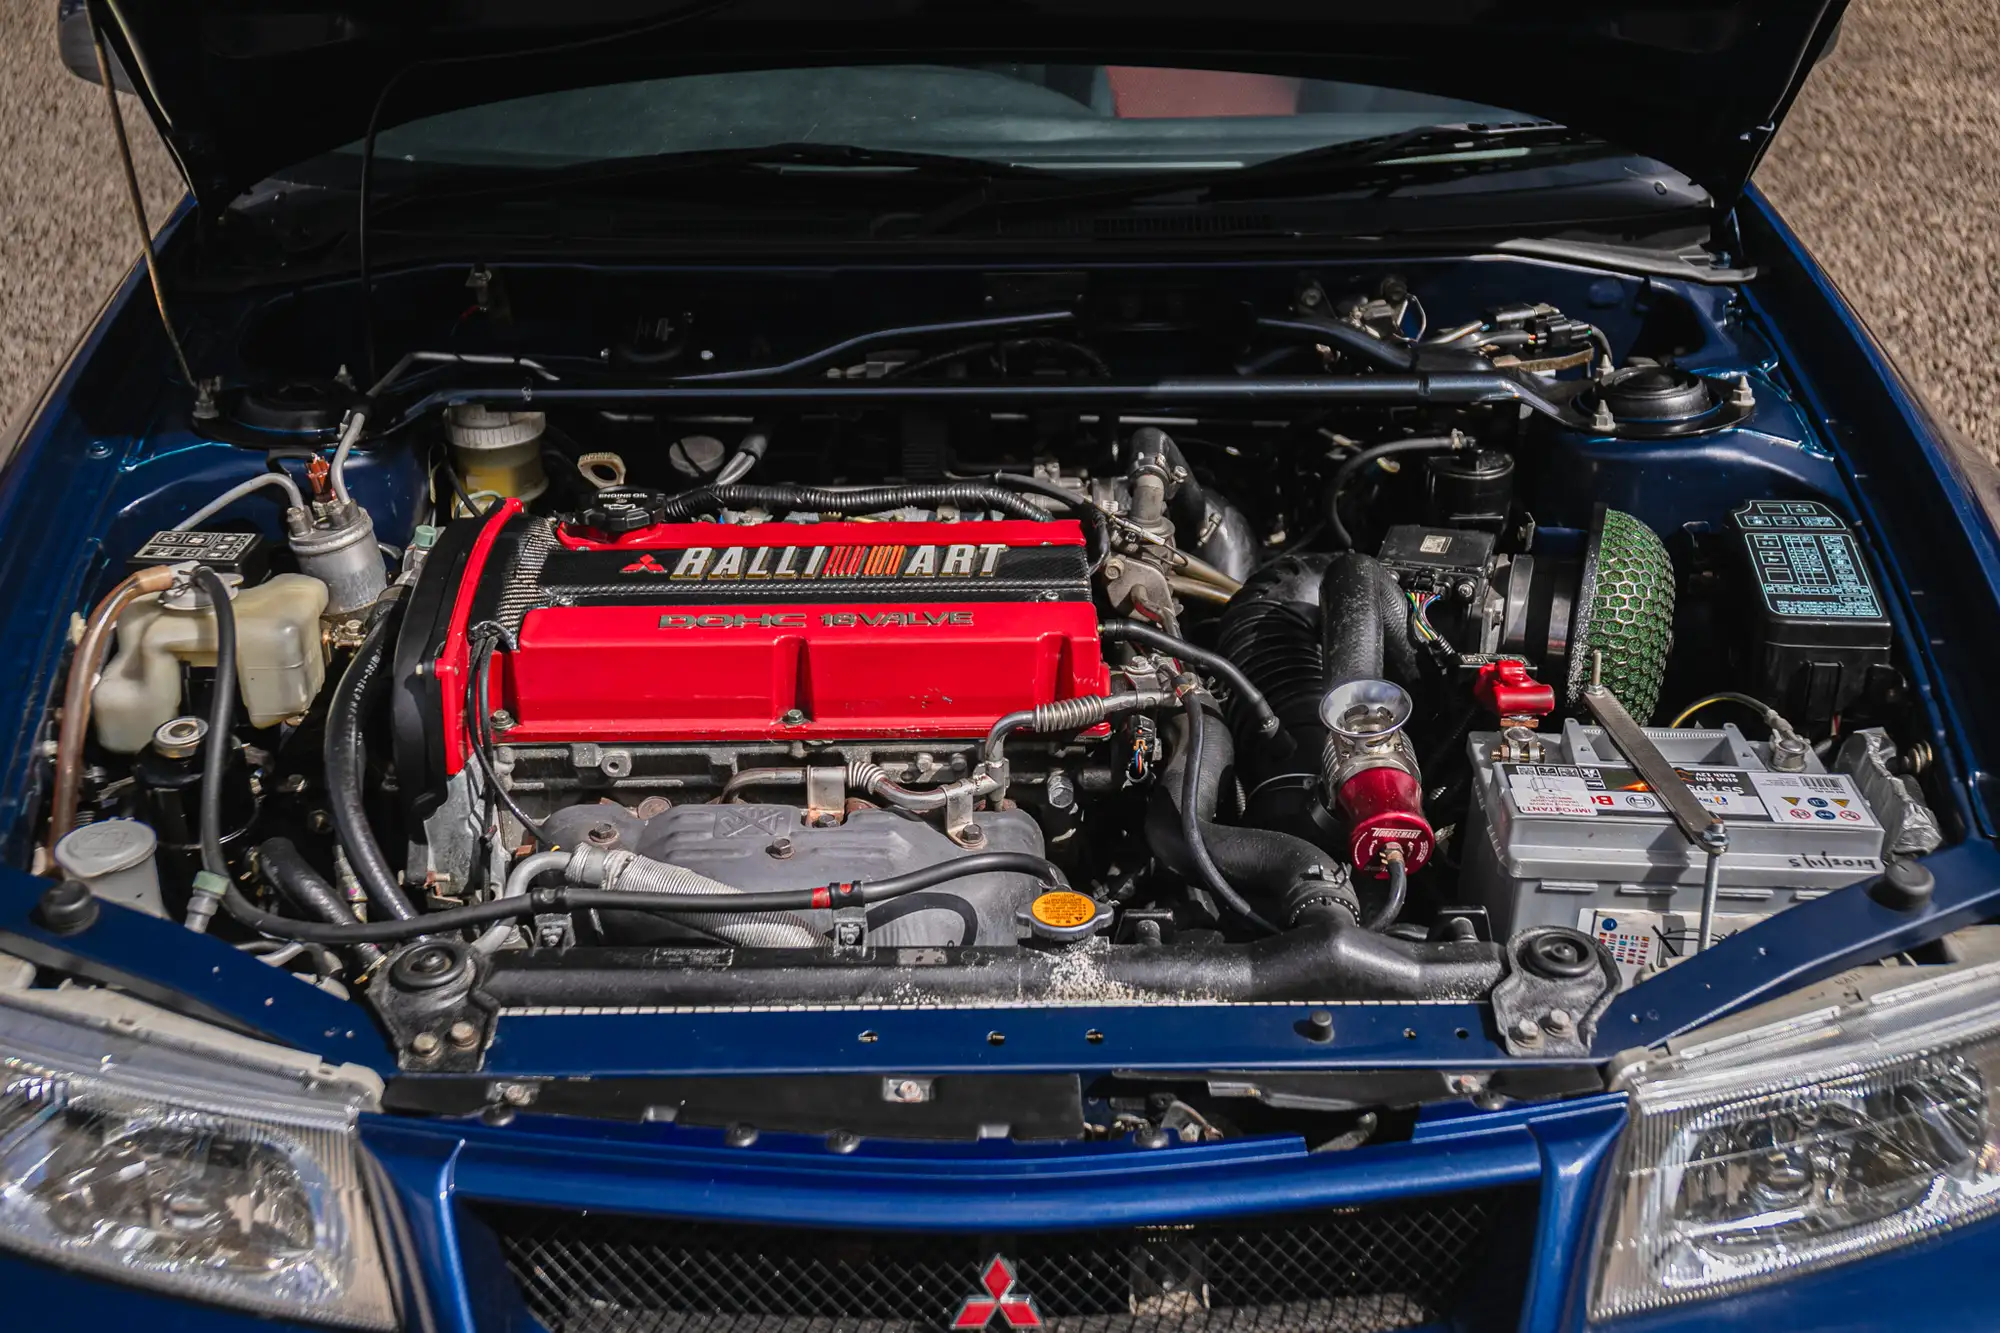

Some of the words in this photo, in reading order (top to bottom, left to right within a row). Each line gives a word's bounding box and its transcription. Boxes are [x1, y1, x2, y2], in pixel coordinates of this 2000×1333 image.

[659, 612, 806, 629] DOHC
[1521, 806, 1591, 814] IMPORTANT!
[1371, 827, 1422, 839] TURBOSMART
